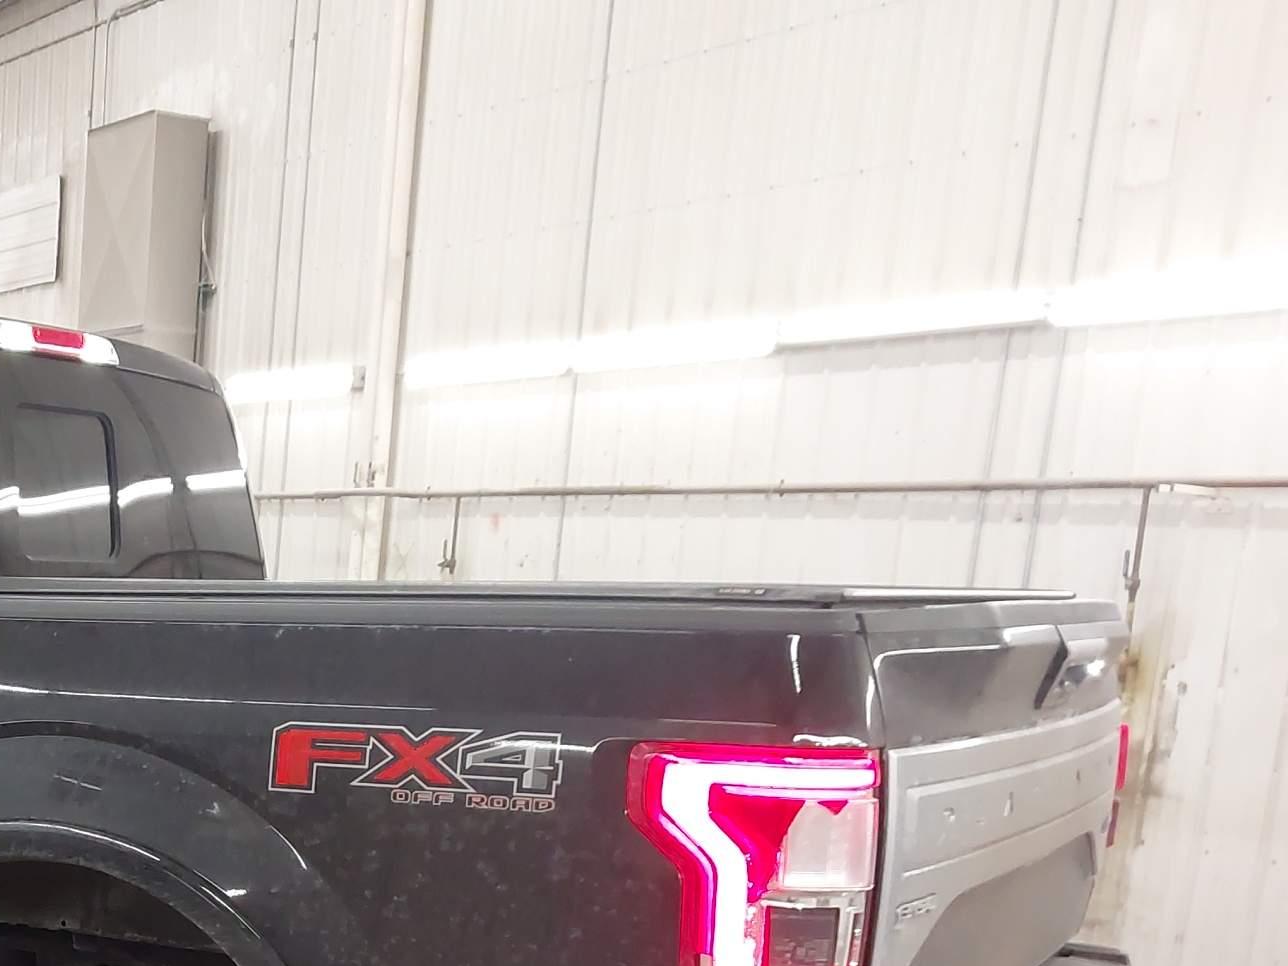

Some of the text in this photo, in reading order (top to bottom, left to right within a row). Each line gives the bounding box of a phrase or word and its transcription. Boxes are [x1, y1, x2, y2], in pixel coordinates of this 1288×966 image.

[268, 721, 563, 798] FX4
[390, 789, 555, 813] OFF ROAD
